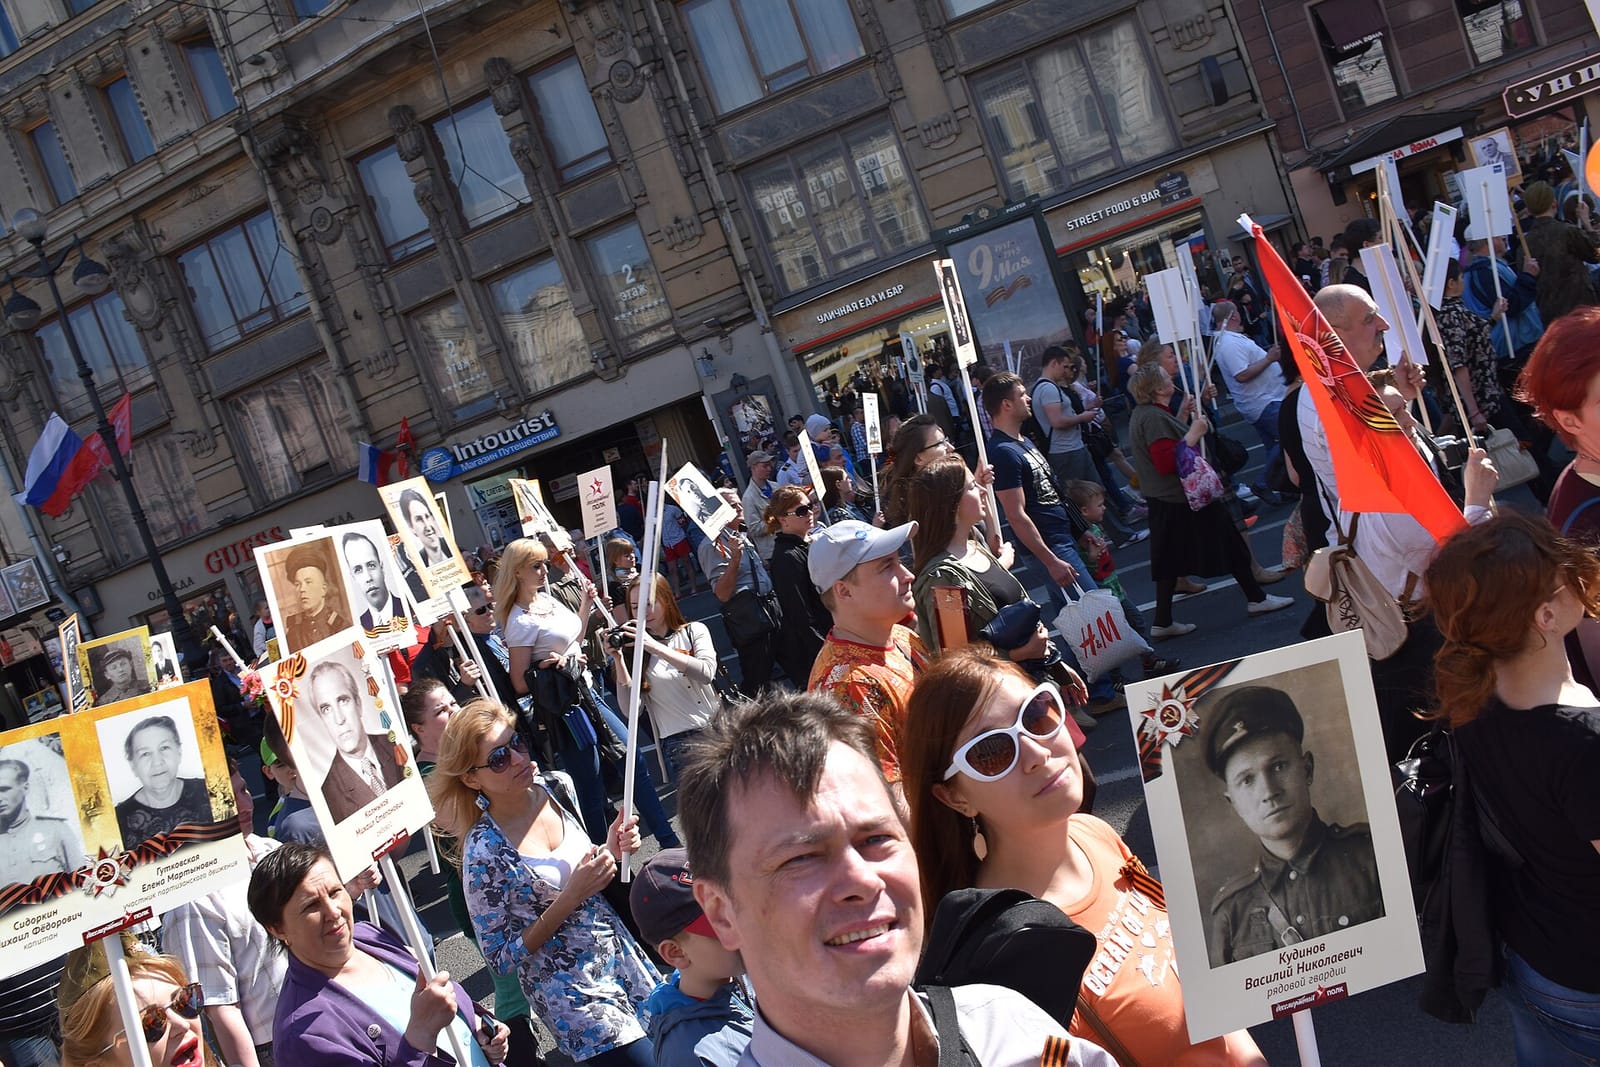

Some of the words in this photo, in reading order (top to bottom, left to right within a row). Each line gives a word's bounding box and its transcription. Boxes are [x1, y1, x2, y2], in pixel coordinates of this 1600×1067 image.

[1006, 202, 1027, 214] POSTER
[1066, 209, 1104, 231] STREET
[1105, 199, 1131, 217] FOOD
[1133, 197, 1140, 207] &
[1140, 188, 1162, 204] BAR
[948, 223, 970, 235] POSTER
[622, 263, 636, 285] 2
[968, 244, 993, 290] 9
[816, 302, 860, 324] УЛИЧНАЯ
[859, 294, 879, 309] ЕДА
[878, 291, 887, 302] И
[886, 284, 905, 298] БАР
[446, 340, 457, 359] 2
[453, 411, 555, 462] Intourist
[460, 451, 499, 473] Магазин
[499, 428, 558, 459] Путешествий
[1079, 610, 1122, 659] H&M
[141, 876, 166, 893] Елена
[167, 858, 218, 882] Мартыновна
[156, 854, 200, 876] Гутковская
[123, 892, 157, 912] участник
[158, 873, 207, 898] партизанского
[0, 931, 30, 949] ихаил
[31, 911, 83, 935] Фёдорович
[13, 908, 58, 931] Сидоркин
[23, 932, 58, 950] капитан
[1279, 943, 1326, 965] Кудинов
[1083, 927, 1134, 997] OCEAN
[1245, 965, 1293, 991] Василий
[1296, 946, 1363, 975] Николаевич
[1267, 977, 1306, 999] рядовой
[1308, 966, 1347, 984] гвардии
